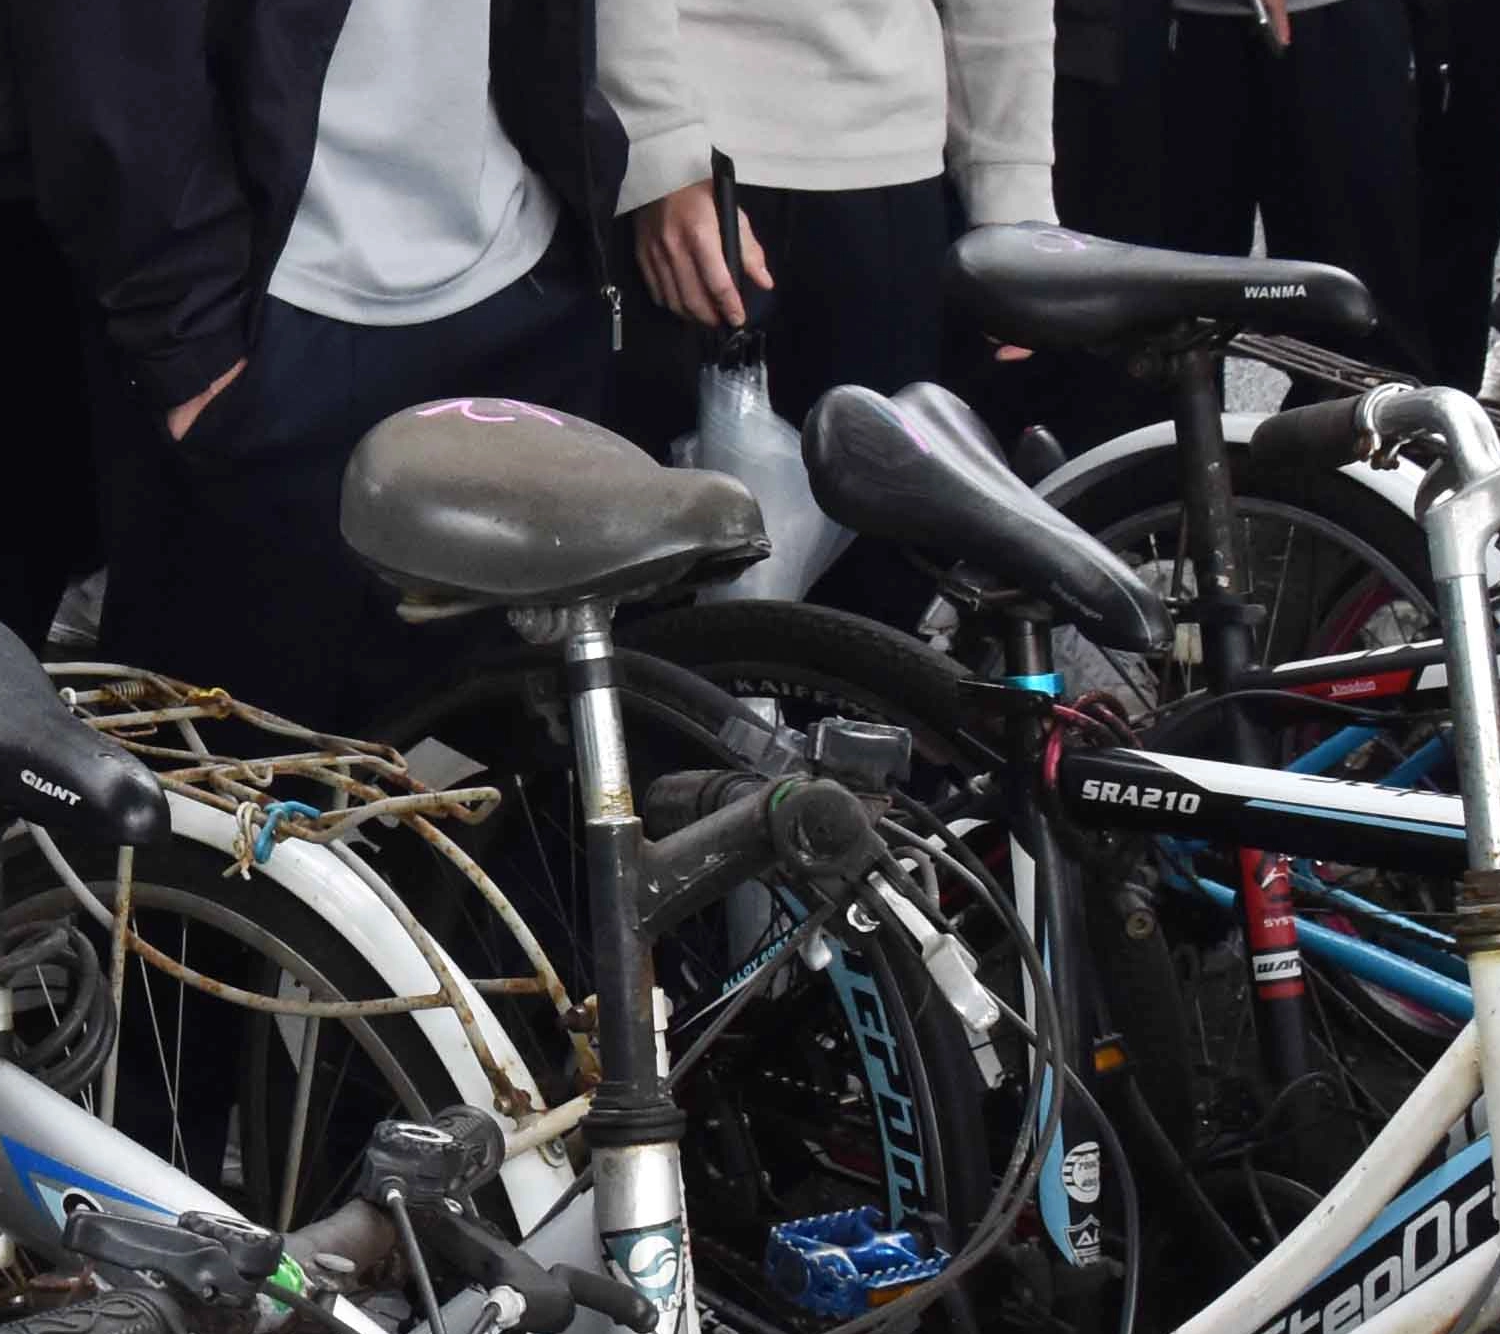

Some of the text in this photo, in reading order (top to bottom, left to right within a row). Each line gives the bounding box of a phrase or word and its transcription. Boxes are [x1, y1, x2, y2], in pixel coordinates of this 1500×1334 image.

[1244, 284, 1308, 299] WANMA
[20, 769, 81, 808] GIANT
[1081, 778, 1201, 814] SRA210
